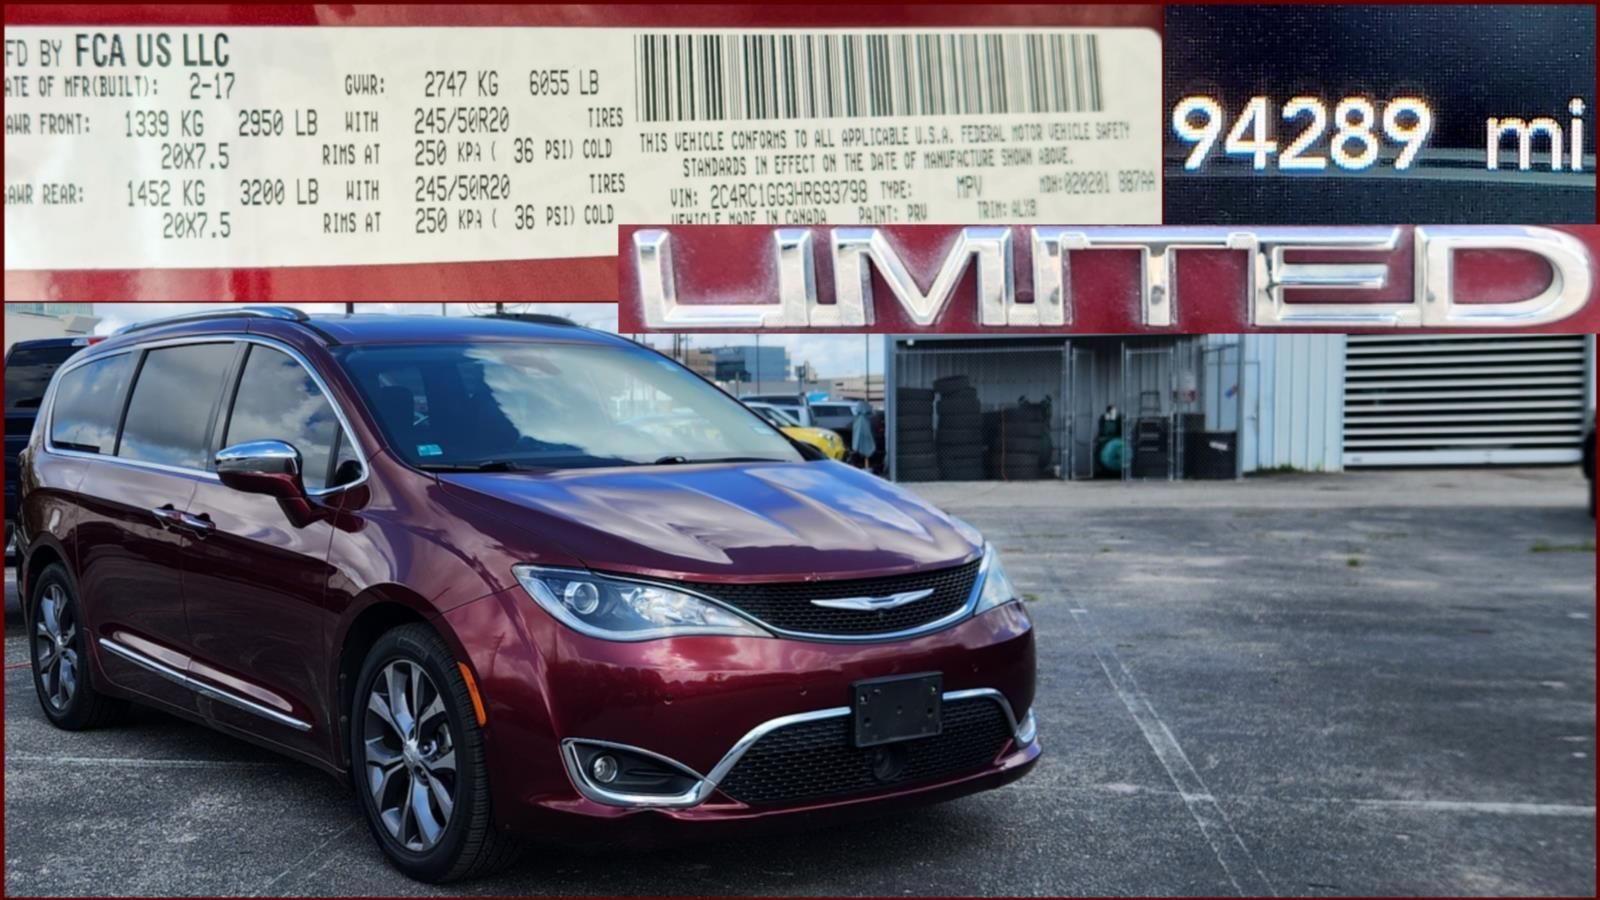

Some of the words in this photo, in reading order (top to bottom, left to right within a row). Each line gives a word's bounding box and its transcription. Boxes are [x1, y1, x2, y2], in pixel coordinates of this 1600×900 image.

[39, 39, 63, 68] BY
[75, 33, 127, 68] FCA
[136, 32, 172, 68] US
[182, 32, 230, 68] LLC
[37, 75, 55, 98] OF
[189, 71, 236, 101] 2-17
[344, 73, 385, 96] GVWR:
[424, 70, 468, 98] 2747
[477, 70, 499, 97] KG
[529, 69, 570, 97] 6055
[579, 69, 600, 96] LB
[39, 112, 91, 135] FRONT:
[124, 109, 170, 138] 1339
[180, 109, 205, 138] KG
[238, 108, 284, 137] 2950
[295, 108, 318, 137] LB
[345, 110, 379, 133] WITH
[414, 106, 510, 135] 245/50R20
[587, 107, 624, 128] TIRES
[640, 132, 668, 153] THIS
[674, 130, 725, 152] VEHICLE
[731, 129, 788, 151] CONFORMS
[794, 129, 808, 149] TO
[814, 129, 836, 149] ALL
[841, 126, 910, 147] APPLICABLE
[915, 125, 955, 146] U.S.A.
[960, 124, 1006, 144] FEDERAL
[1012, 123, 1043, 142] MOTOR
[1049, 122, 1091, 142] VEHICLE
[1095, 120, 1131, 141] SAFETY
[1172, 93, 1434, 172] 94289
[1486, 95, 1586, 173] mi
[160, 142, 230, 170] 20X7.5
[322, 143, 356, 166] RIMS
[364, 143, 381, 165] AT
[414, 139, 447, 167] 250
[513, 137, 534, 164] 36
[582, 137, 613, 160] COLD
[682, 156, 747, 179] STANDARDS
[754, 155, 768, 176] IN
[774, 153, 816, 175] EFFECT
[822, 153, 837, 173] ON
[843, 152, 865, 173] THE
[870, 151, 898, 172] DATE
[904, 150, 917, 170] OF
[923, 148, 996, 170] MANUFACTURE
[1001, 148, 1033, 167] SHOWN
[1038, 146, 1074, 166] ABOVE.
[4, 183, 34, 205] AWR
[42, 183, 84, 205] REAR:
[127, 179, 172, 208] 1452
[182, 179, 206, 207] KG
[239, 178, 285, 207] 3200
[296, 178, 319, 206] LB
[345, 179, 380, 202] WITH
[415, 173, 511, 203] 245/50R20
[588, 172, 626, 194] TIRES
[669, 188, 700, 208] VIN:
[710, 179, 869, 210] 2C4RC1GG3HR693798
[880, 180, 913, 201] TYPE:
[956, 174, 984, 200] MPV
[162, 211, 232, 240] 20X7.5
[323, 212, 357, 234] RIMS
[364, 211, 382, 233] AT
[415, 207, 448, 235] 250
[514, 204, 535, 231] 36
[583, 203, 615, 225] COLD
[765, 209, 780, 225] IN
[784, 207, 828, 225] CANADA
[858, 204, 900, 224] PAINT:
[976, 199, 1008, 220] TRIM:
[632, 226, 1592, 328] LIMITED
